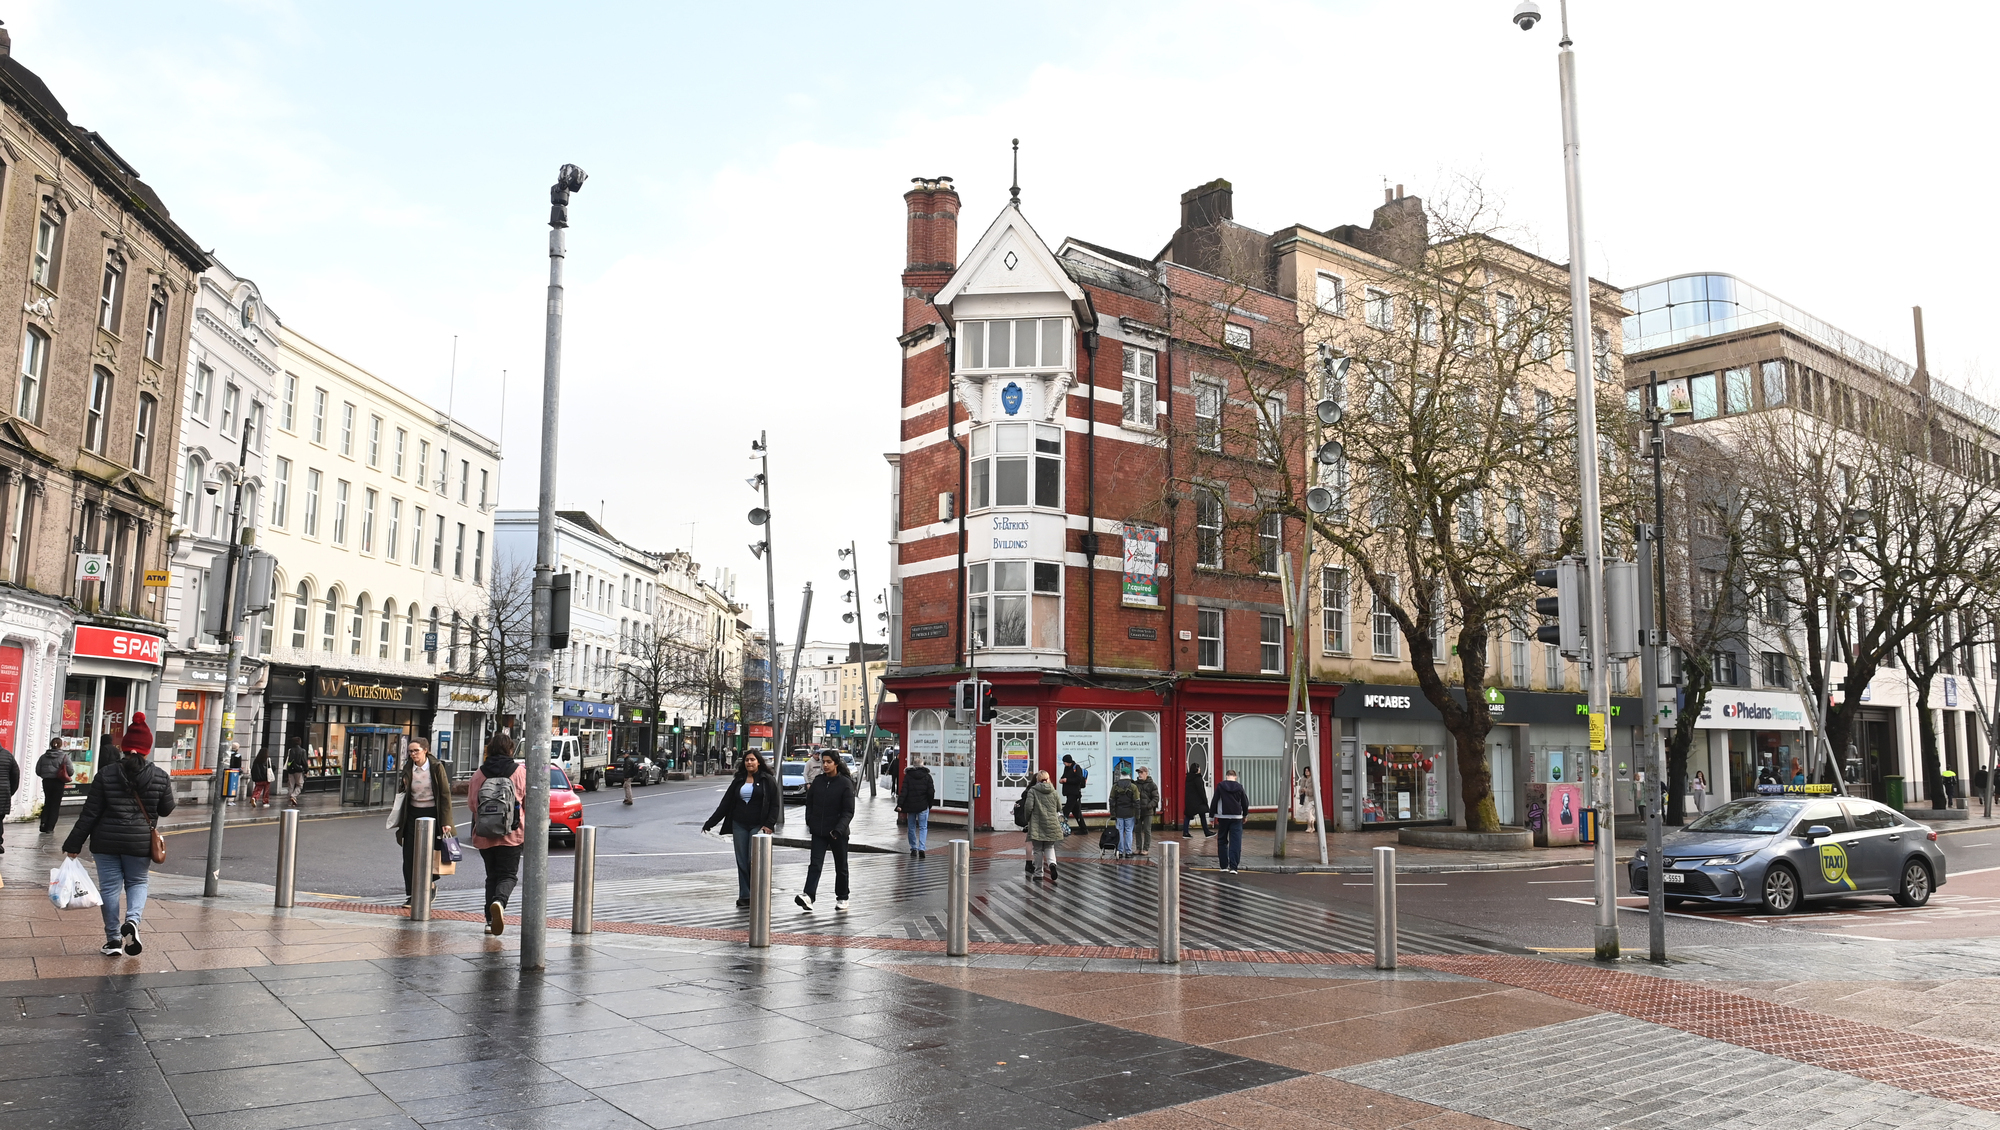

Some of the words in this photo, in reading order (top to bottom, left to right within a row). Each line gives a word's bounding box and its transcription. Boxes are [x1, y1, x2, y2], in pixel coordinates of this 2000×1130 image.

[1127, 583, 1152, 592] Acquired
[113, 636, 159, 659] SPAR
[1, 692, 14, 703] LET
[347, 684, 402, 701] WATERSTONES
[1489, 704, 1505, 712] CABES
[1576, 704, 1621, 716] PHCY
[1736, 702, 1772, 720] Phelans
[1772, 707, 1802, 724] Pharmacy
[1823, 855, 1844, 869] TAXI
